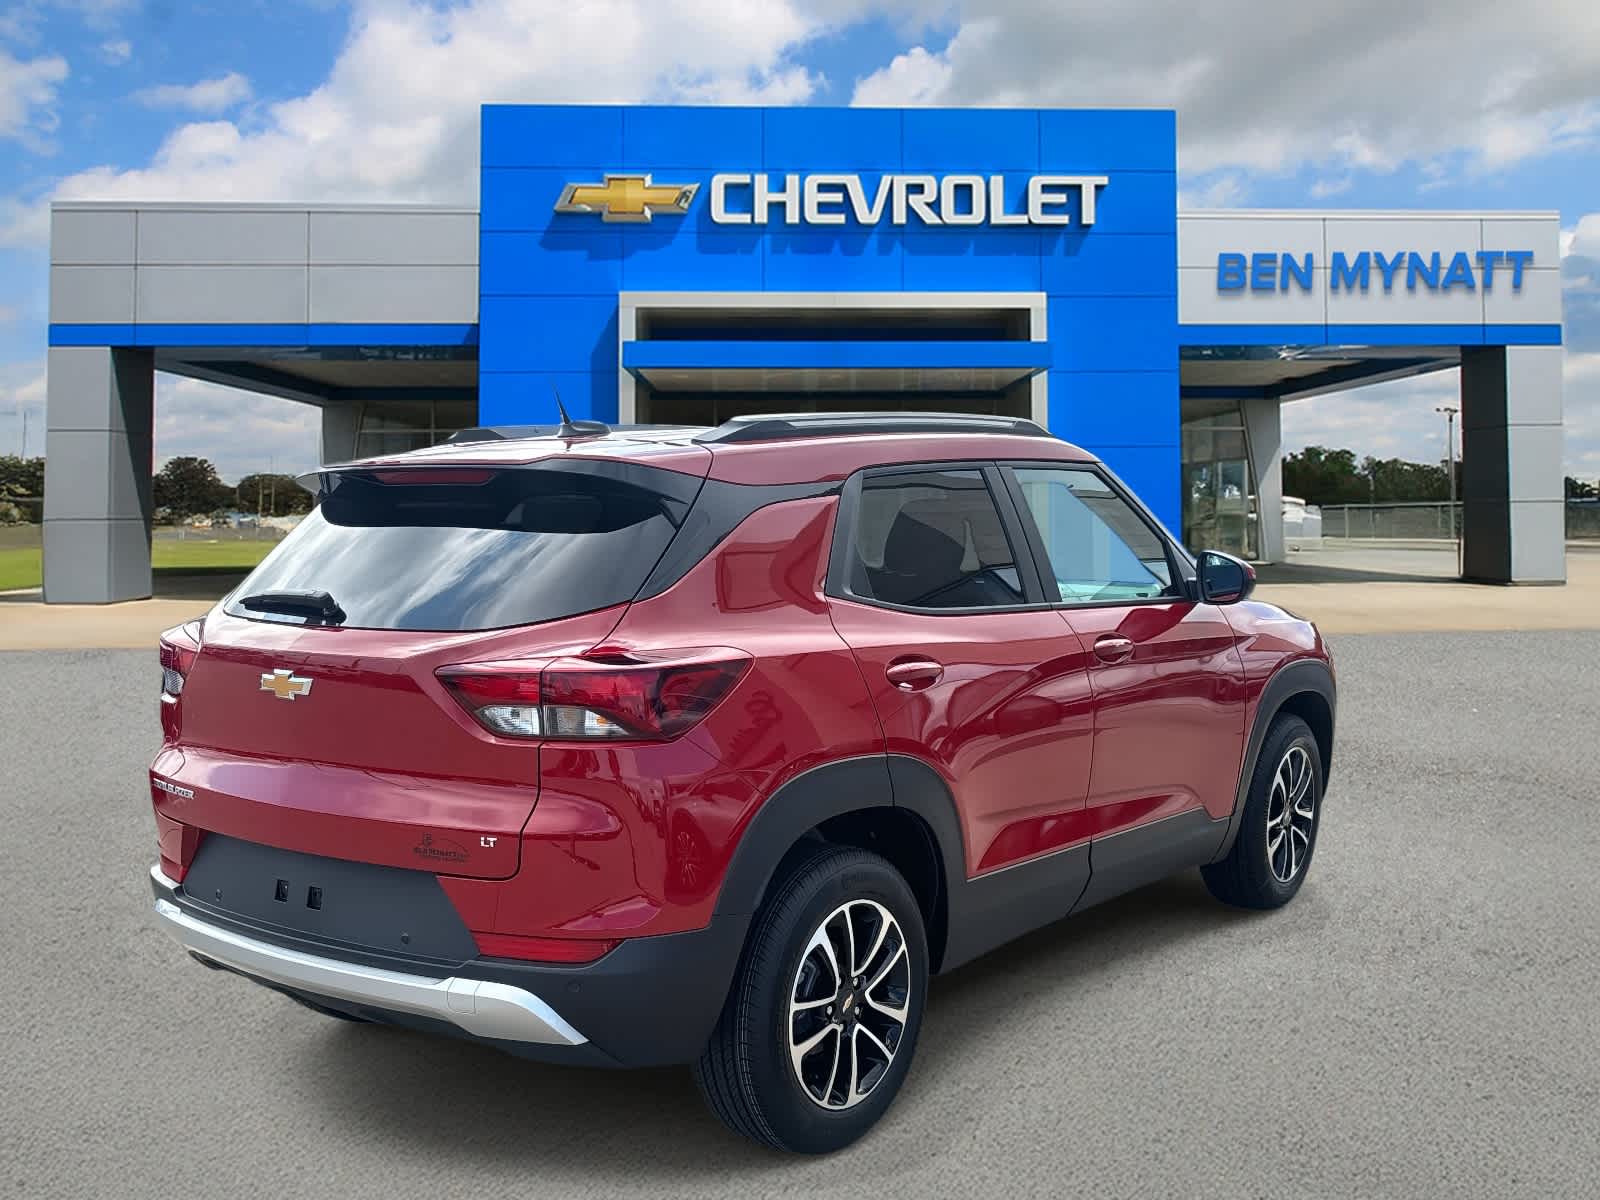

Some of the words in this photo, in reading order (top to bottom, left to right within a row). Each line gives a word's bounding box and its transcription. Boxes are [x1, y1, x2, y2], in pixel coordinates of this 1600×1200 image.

[710, 173, 1109, 225] CHEVROLET
[1217, 252, 1313, 290] BEN
[1330, 251, 1534, 290] MYNATT
[480, 836, 498, 848] LT
